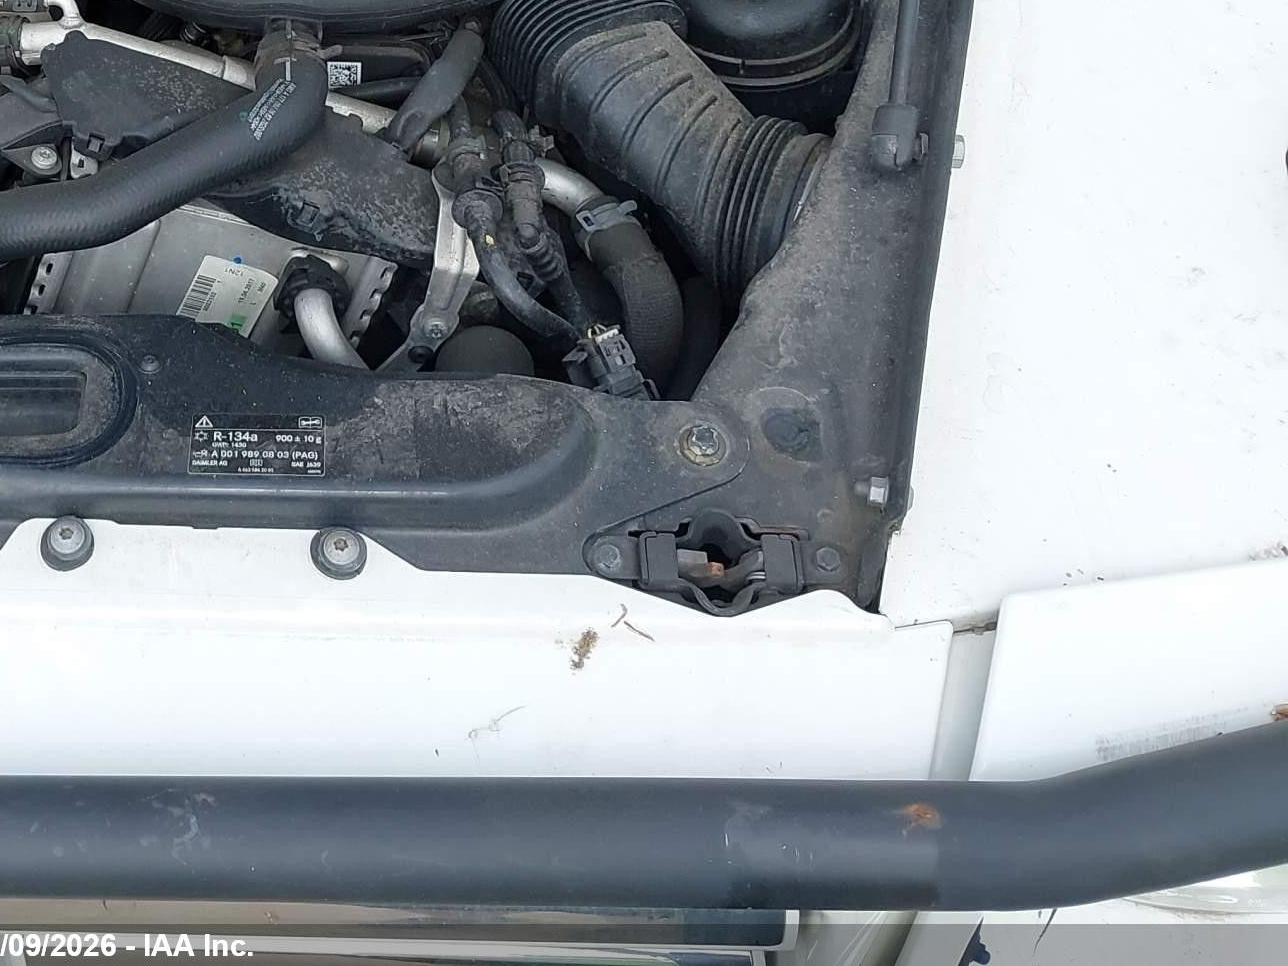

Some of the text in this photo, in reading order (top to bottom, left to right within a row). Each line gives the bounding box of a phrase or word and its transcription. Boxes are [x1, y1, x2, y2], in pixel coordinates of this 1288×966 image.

[213, 431, 258, 442] R-134a
[211, 450, 218, 458] A
[220, 450, 238, 458] 001
[241, 450, 259, 458] 989
[262, 450, 274, 458] 08
[292, 450, 318, 460] (PAG)
